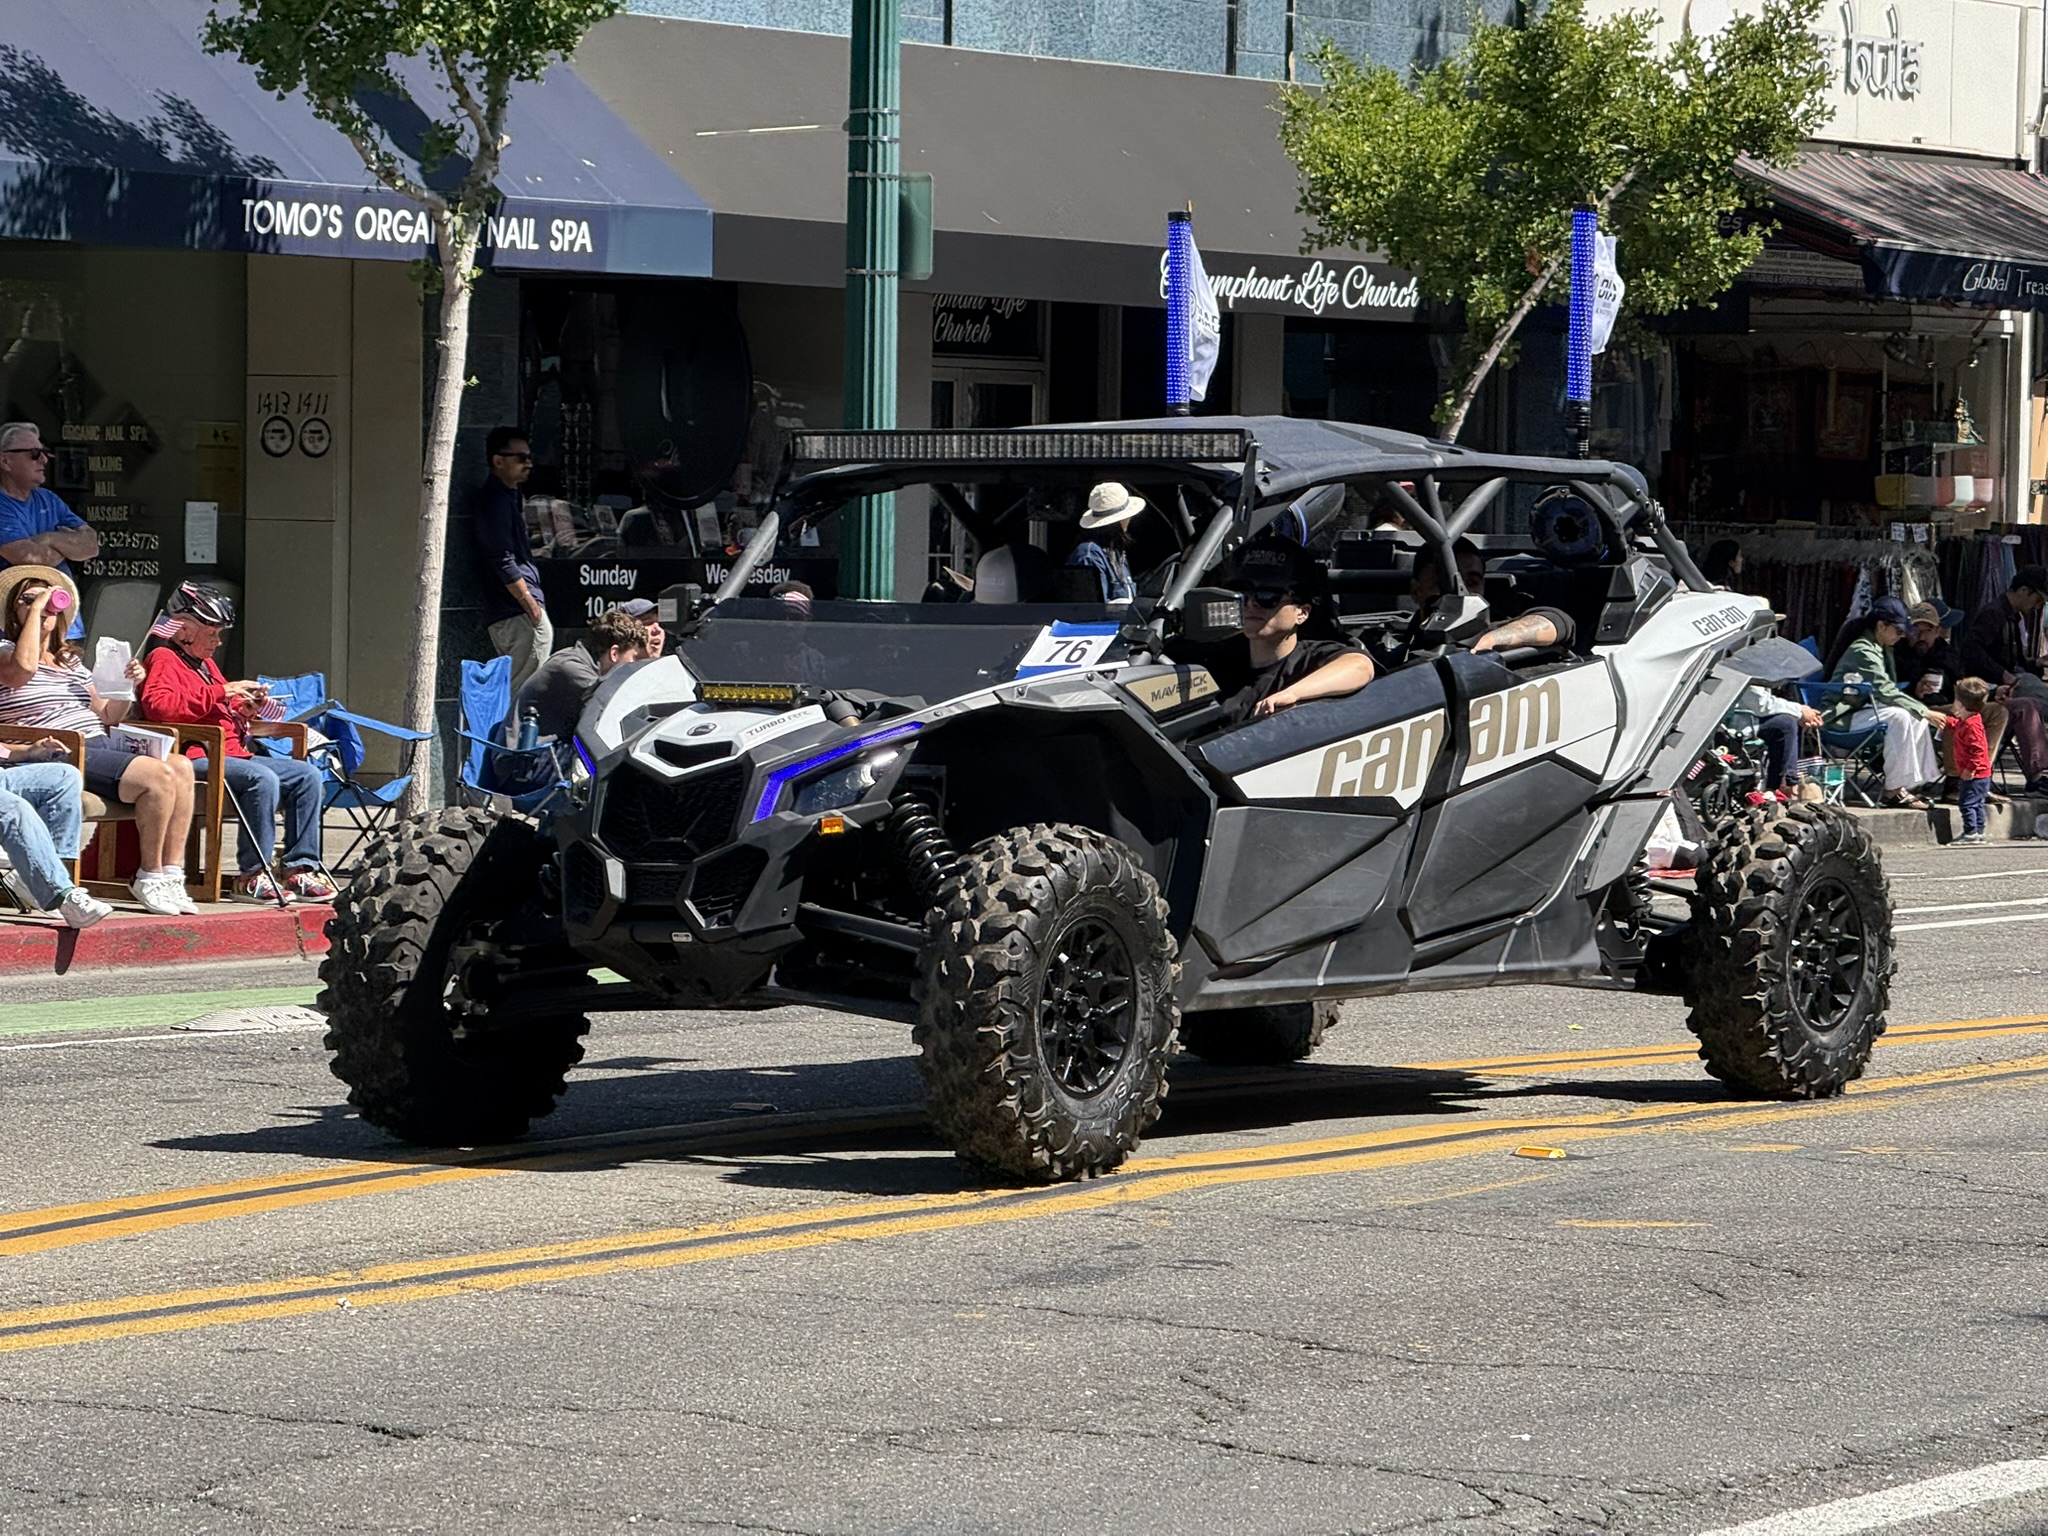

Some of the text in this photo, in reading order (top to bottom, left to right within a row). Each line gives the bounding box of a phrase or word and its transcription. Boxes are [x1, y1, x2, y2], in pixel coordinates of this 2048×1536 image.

[242, 198, 593, 253] TOMO'S ORGA NAIL SPA
[1293, 260, 1340, 317] Life
[1342, 264, 1420, 309] Church
[1962, 262, 2011, 292] Global
[933, 312, 992, 344] Church
[256, 391, 291, 416] 1413
[61, 424, 148, 442] ORGANIC NAIL SPA
[88, 455, 123, 473] WAXING
[94, 480, 117, 497] NAIL
[86, 505, 129, 522] MASSAGE
[97, 530, 159, 551] 0-521-8778
[579, 562, 791, 591] Sunday Weesday
[584, 595, 605, 618] 10
[1044, 639, 1093, 664] 76
[745, 717, 786, 737] TURBO
